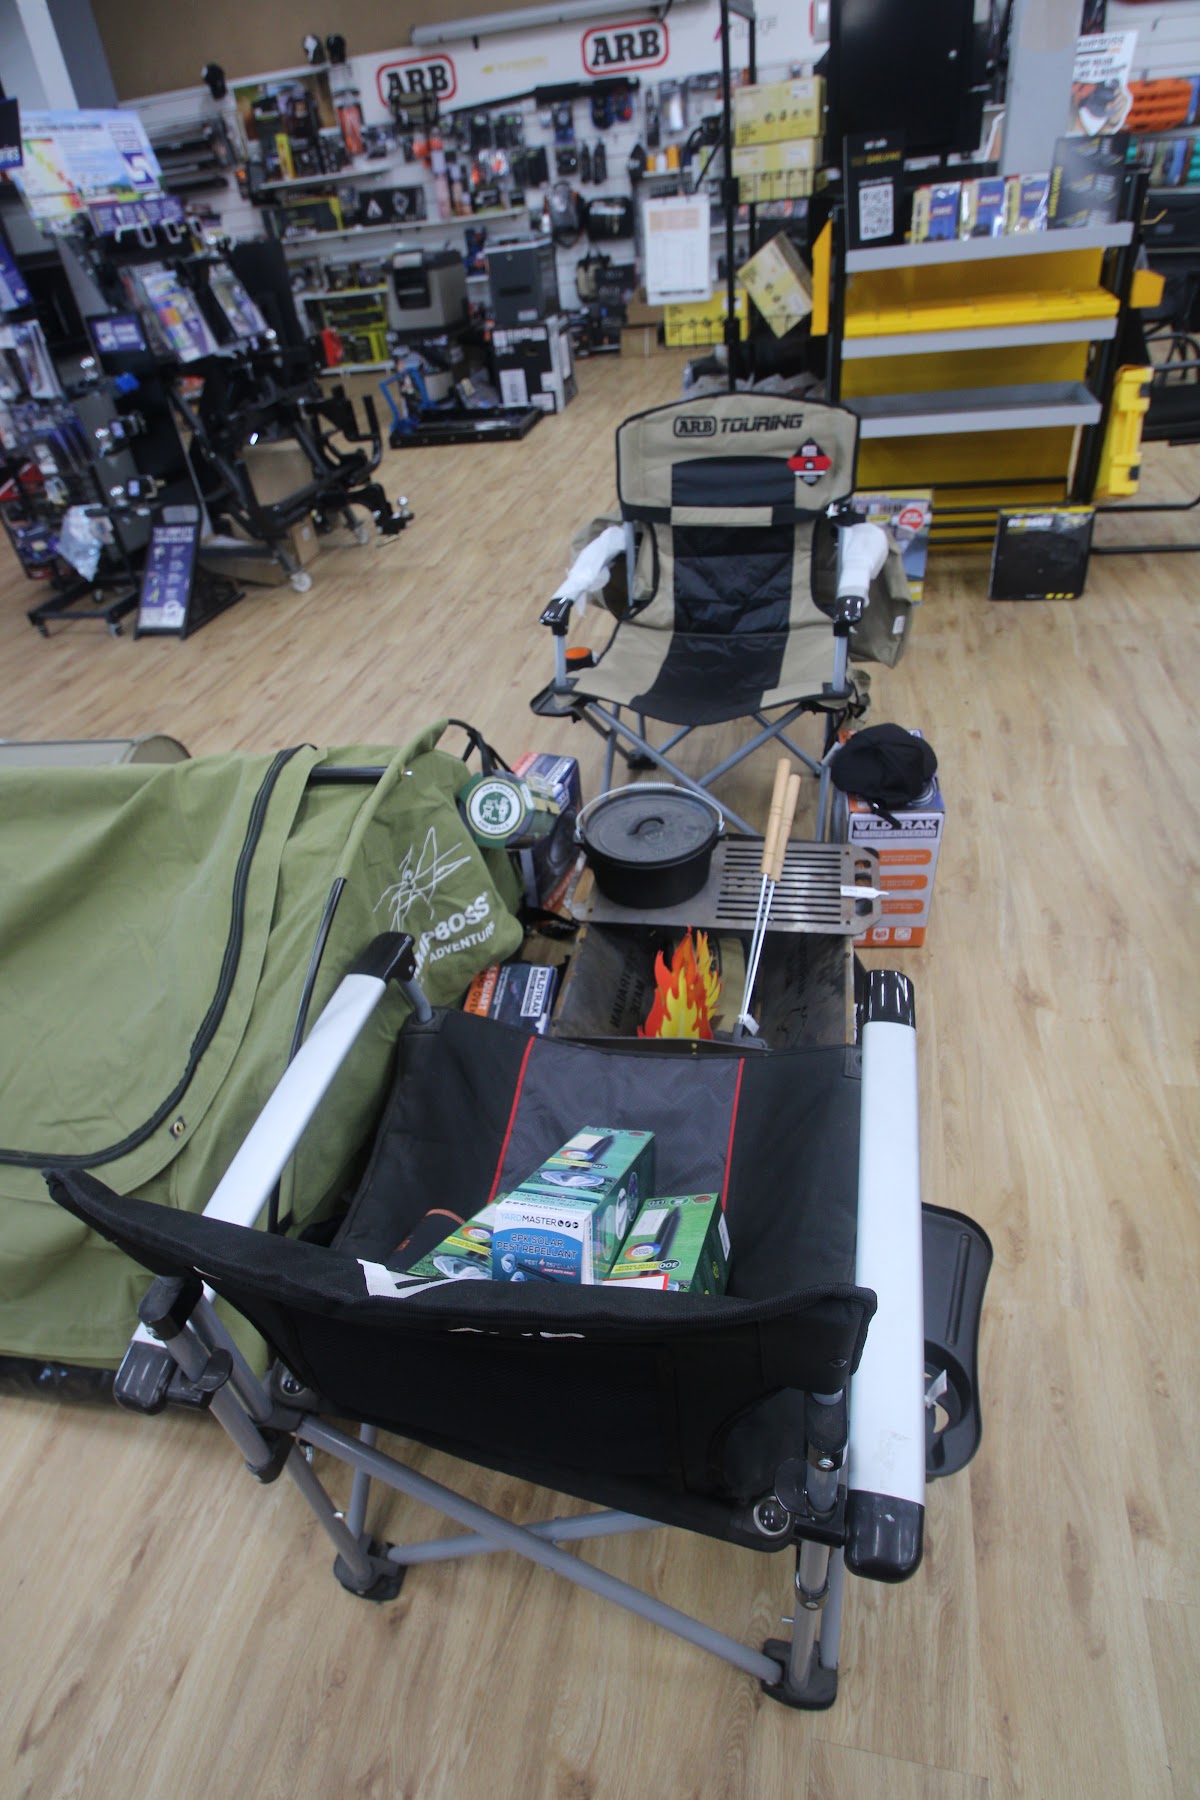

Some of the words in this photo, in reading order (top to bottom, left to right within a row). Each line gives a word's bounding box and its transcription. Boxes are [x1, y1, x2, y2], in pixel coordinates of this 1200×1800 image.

[592, 29, 661, 66] ARB
[387, 65, 448, 97] ARB
[678, 420, 714, 435] ARB
[720, 413, 804, 434] TOURING
[854, 820, 937, 831] WILDRAK
[500, 1213, 557, 1227] YARDMASTER
[510, 1234, 530, 1242] 2PK
[532, 1235, 564, 1248] SOLAR
[496, 1242, 521, 1252] PEST
[522, 1245, 578, 1260] REPELLANT
[546, 1262, 578, 1270] REPELLANT
[660, 1261, 679, 1269] 300
